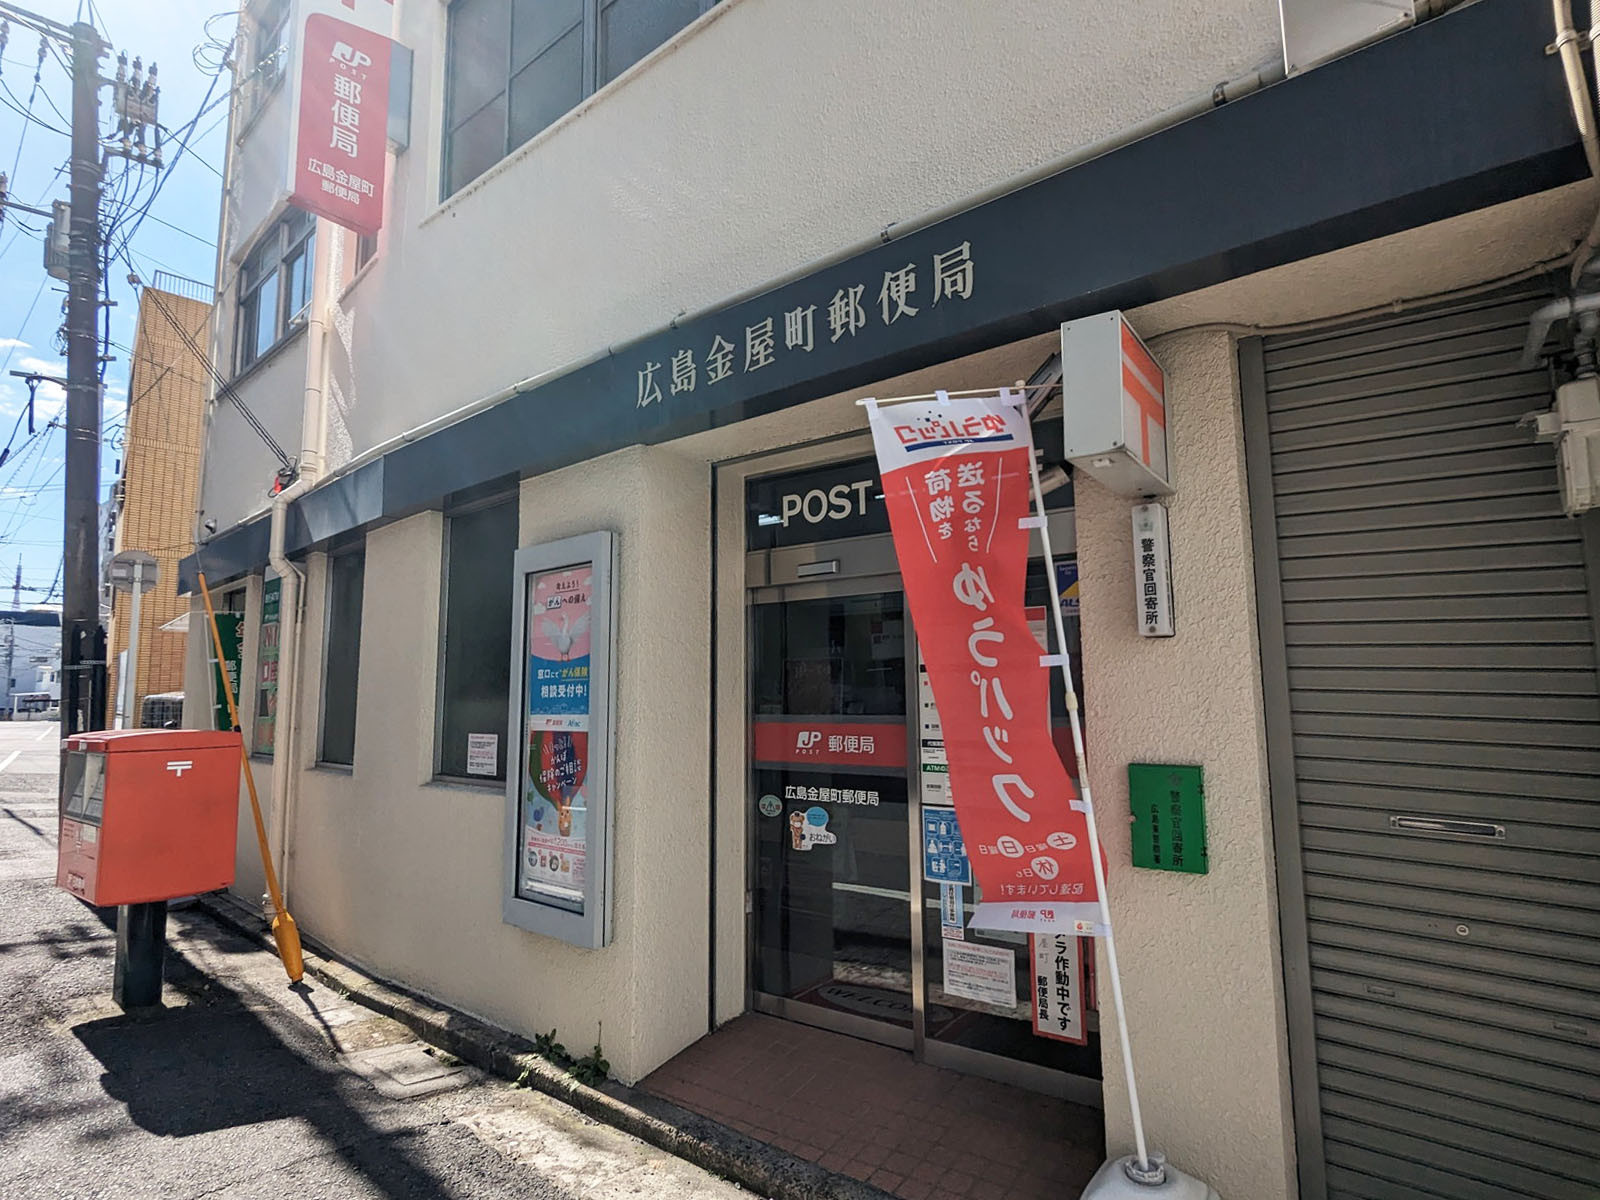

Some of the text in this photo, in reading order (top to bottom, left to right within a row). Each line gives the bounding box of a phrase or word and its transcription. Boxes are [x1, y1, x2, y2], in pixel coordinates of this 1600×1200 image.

[328, 57, 368, 80] POST
[329, 72, 362, 158] 郵便局
[307, 158, 375, 198] 広島金屋町
[321, 179, 360, 205] 郵便局
[635, 241, 976, 409] 広島金屋町郵便局
[782, 480, 873, 528] POST
[1141, 537, 1159, 625] 警察官回寄所
[828, 735, 875, 754] 郵便局
[785, 785, 880, 806] 広島金屋町郵便局
[1037, 975, 1049, 1021] 郵便局長
